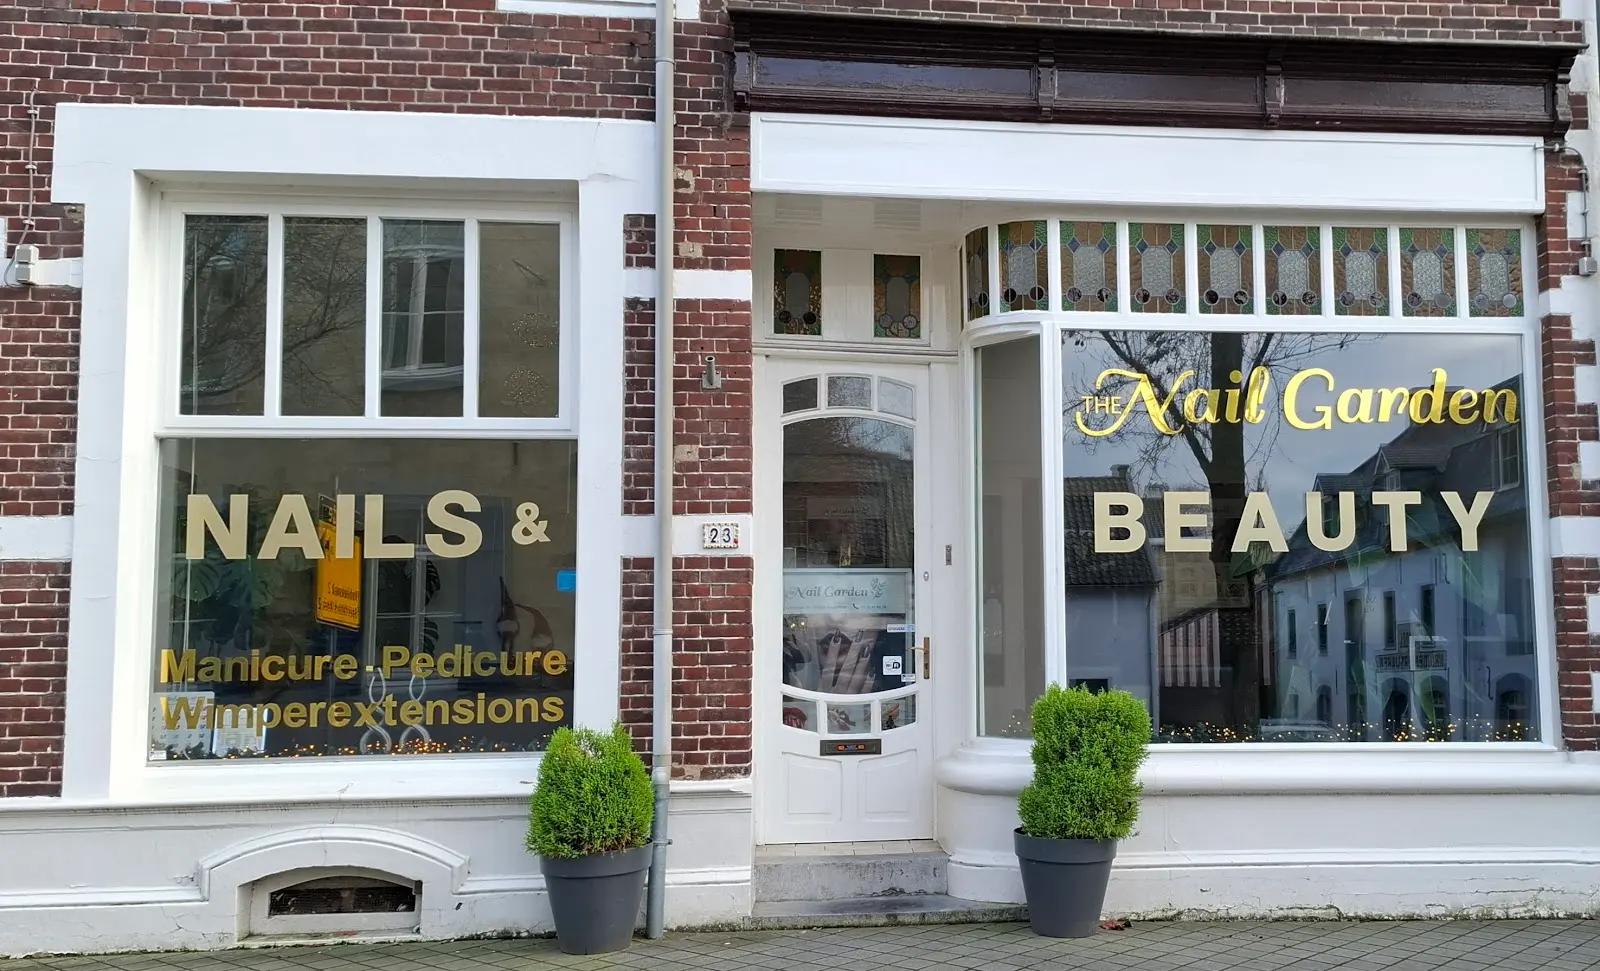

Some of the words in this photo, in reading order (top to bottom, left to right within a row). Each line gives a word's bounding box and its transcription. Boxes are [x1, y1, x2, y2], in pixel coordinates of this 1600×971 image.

[1075, 366, 1270, 437] Nail
[1081, 396, 1121, 415] THE
[1283, 367, 1520, 430] Garden
[185, 489, 482, 560] NAILS
[511, 501, 551, 546] &
[710, 527, 731, 543] 23
[1093, 491, 1495, 554] BEAUTY
[785, 586, 822, 600] Nail
[824, 585, 868, 598] Garden
[160, 648, 358, 683] Manicure
[383, 643, 568, 679] Pedicure
[160, 692, 566, 737] Wimperextensions
